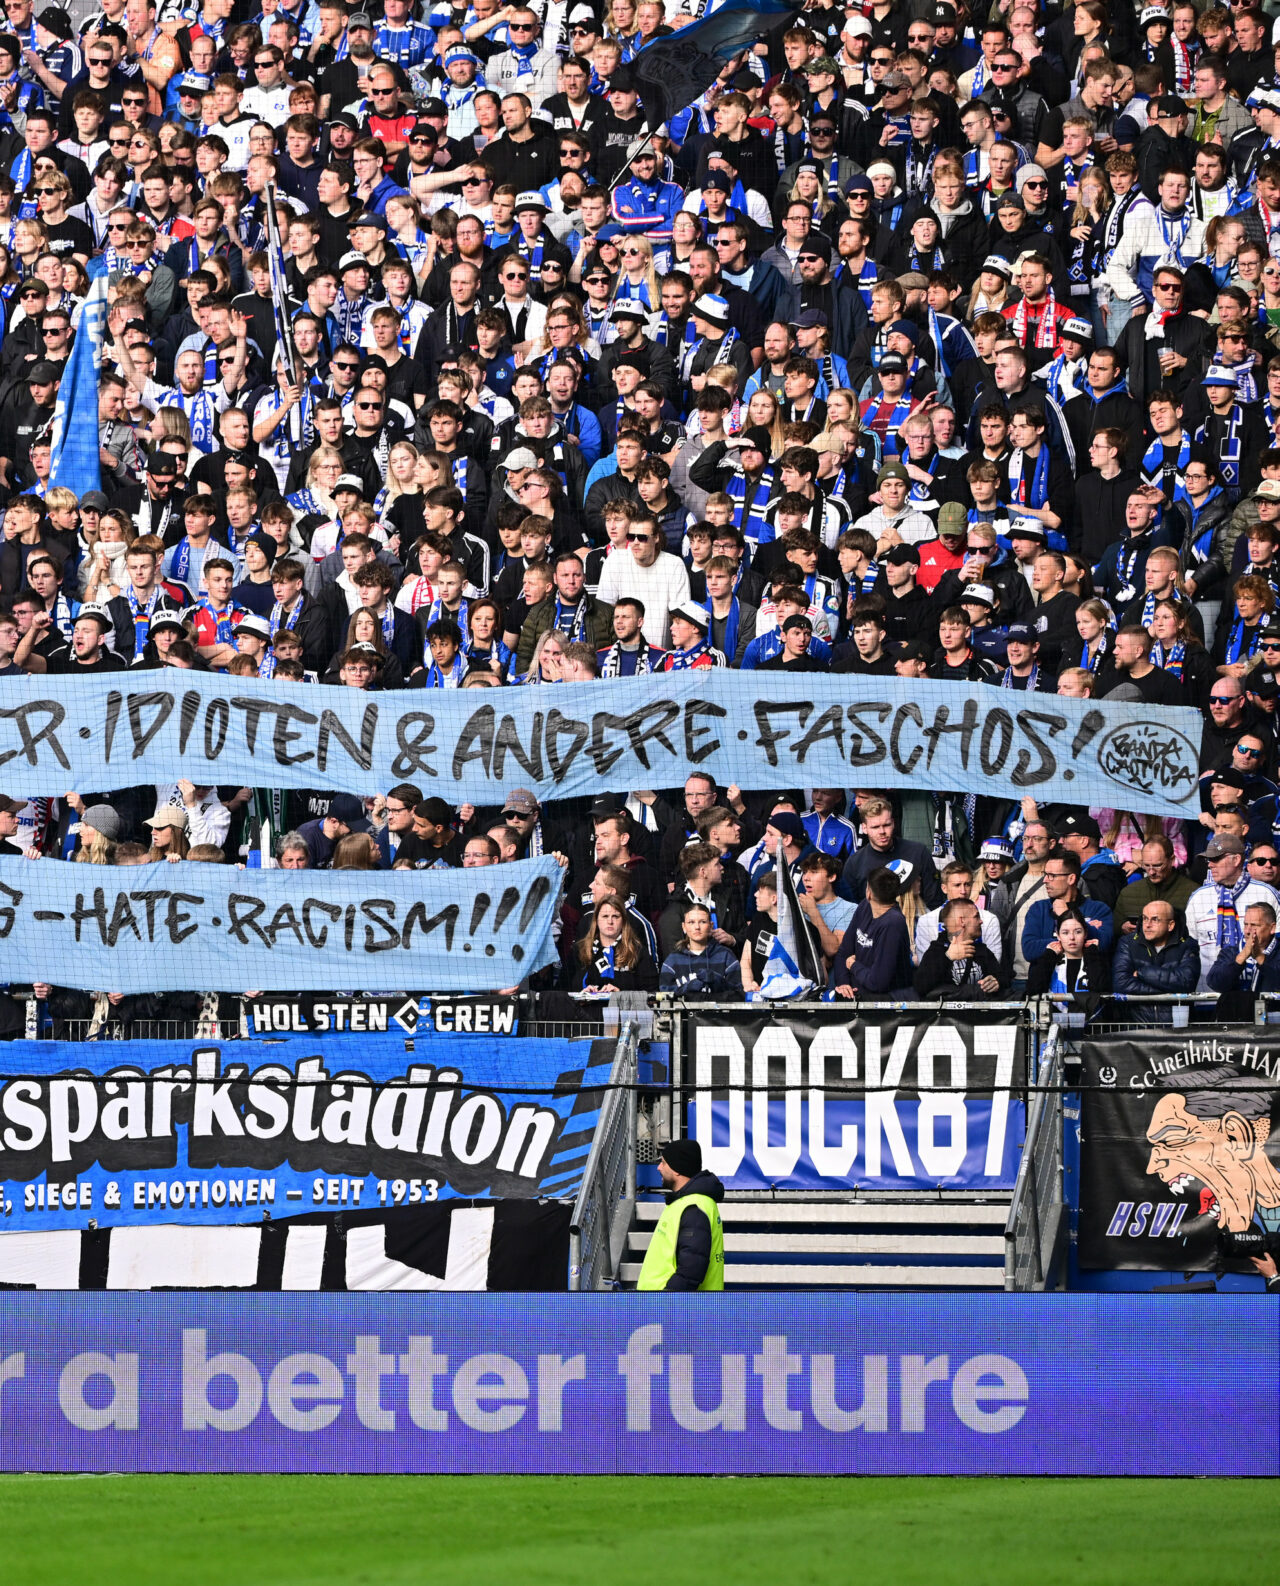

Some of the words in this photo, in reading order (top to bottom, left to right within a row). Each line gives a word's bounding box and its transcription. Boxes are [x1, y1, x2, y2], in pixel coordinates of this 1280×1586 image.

[1069, 322, 1087, 333] HSV
[154, 612, 173, 621] HSV
[105, 690, 378, 772] IDIOTEN
[391, 711, 437, 778] &
[452, 698, 727, 783] ANDERE
[754, 698, 1106, 787] FASCHOS!
[1111, 733, 1183, 760] BANDA
[70, 886, 205, 947] HATE
[228, 876, 551, 962] RACISM!!!
[252, 1002, 388, 1032] HOLSTEN
[435, 1004, 515, 1034] CREW
[694, 1025, 1018, 1178] DOCK87
[24, 1182, 93, 1206] SIEGE
[104, 1182, 122, 1206] &
[133, 1178, 277, 1205] EMOTIONEN
[312, 1178, 365, 1203] SEIT
[376, 1178, 440, 1201] 1953
[1106, 1201, 1188, 1238] HSV!
[58, 1350, 140, 1433] a
[181, 1327, 587, 1433] better
[618, 1323, 1030, 1433] future
